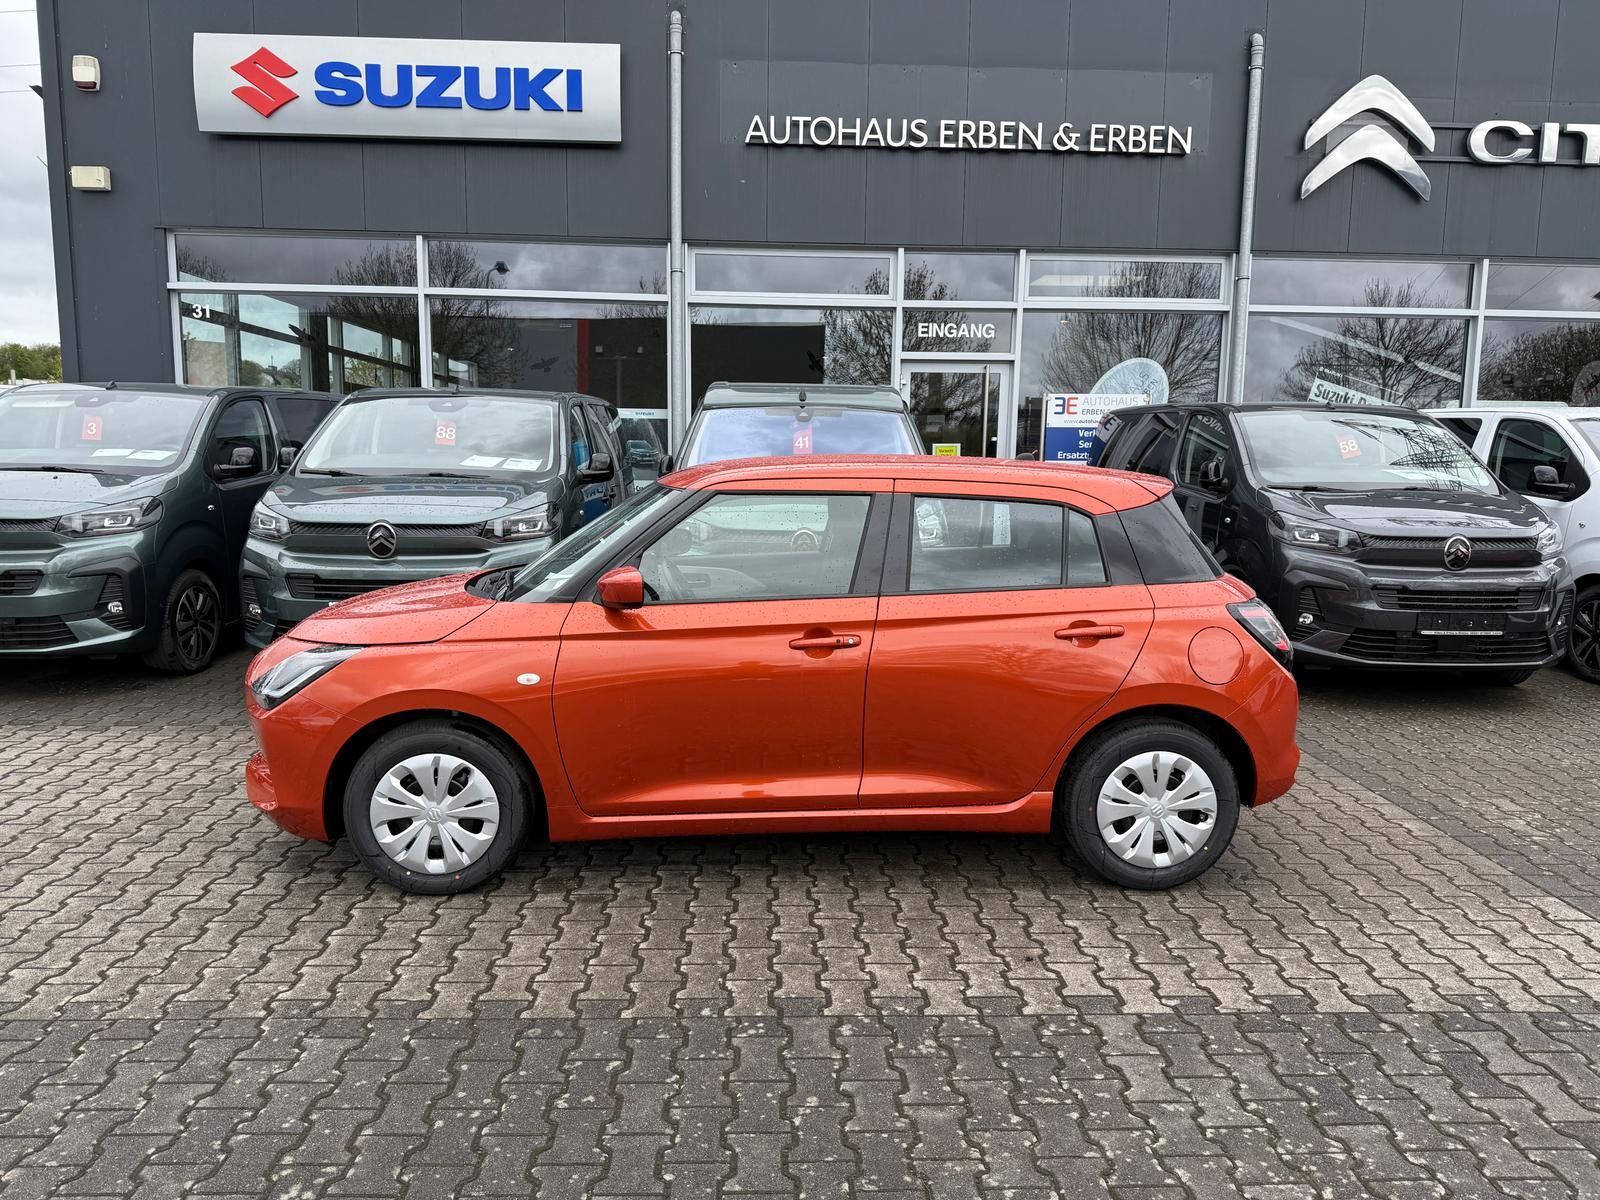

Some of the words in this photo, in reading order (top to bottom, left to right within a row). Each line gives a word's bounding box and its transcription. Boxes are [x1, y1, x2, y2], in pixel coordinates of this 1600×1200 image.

[314, 61, 583, 112] SUZUKI
[744, 114, 928, 148] AUTOHAUS
[939, 119, 1043, 150] ERBEN
[1052, 122, 1081, 151] &
[1089, 123, 1193, 154] ERBEN
[192, 303, 211, 319] 31
[917, 322, 996, 339] EINGANG
[1082, 396, 1139, 407] AUTOHAUS
[1081, 408, 1105, 416] ERBEN
[87, 422, 97, 435] 3
[436, 426, 456, 440] 88
[794, 436, 809, 449] 41
[1340, 439, 1358, 453] 58
[1057, 451, 1089, 460] Ersatzt
